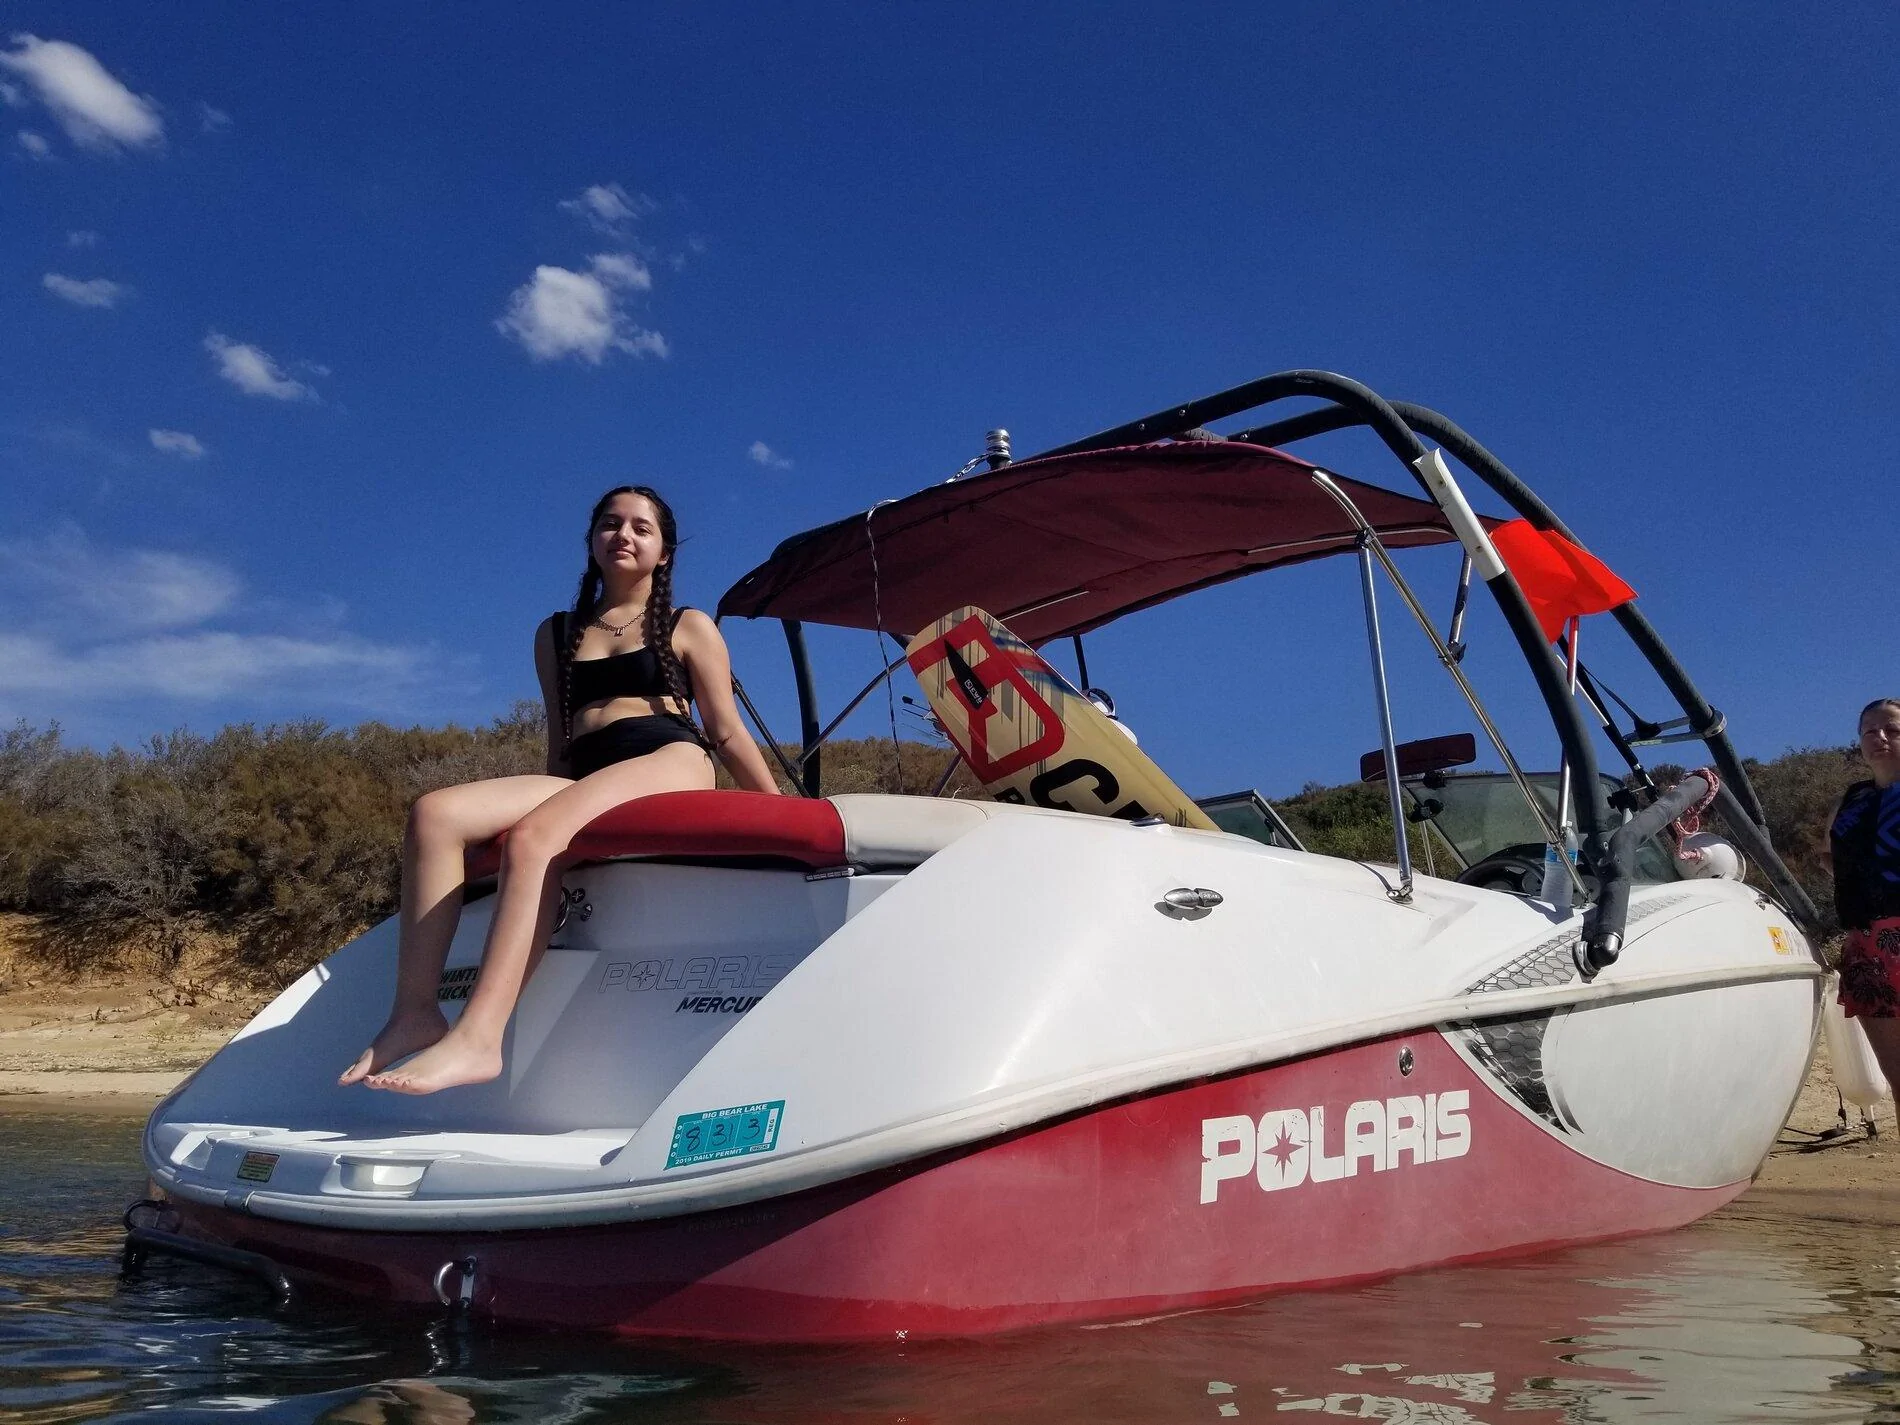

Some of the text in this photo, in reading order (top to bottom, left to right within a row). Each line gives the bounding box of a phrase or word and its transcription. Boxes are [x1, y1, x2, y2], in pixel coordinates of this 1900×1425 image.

[599, 953, 796, 993] POLARIS
[702, 1111, 717, 1120] BIG
[719, 1108, 743, 1117] BEAR
[744, 1103, 768, 1112] LAKE
[685, 1126, 701, 1152] 8
[1200, 1089, 1471, 1204] POLARIS
[693, 1152, 714, 1162] DAILY
[715, 1148, 743, 1158] PERMIT
